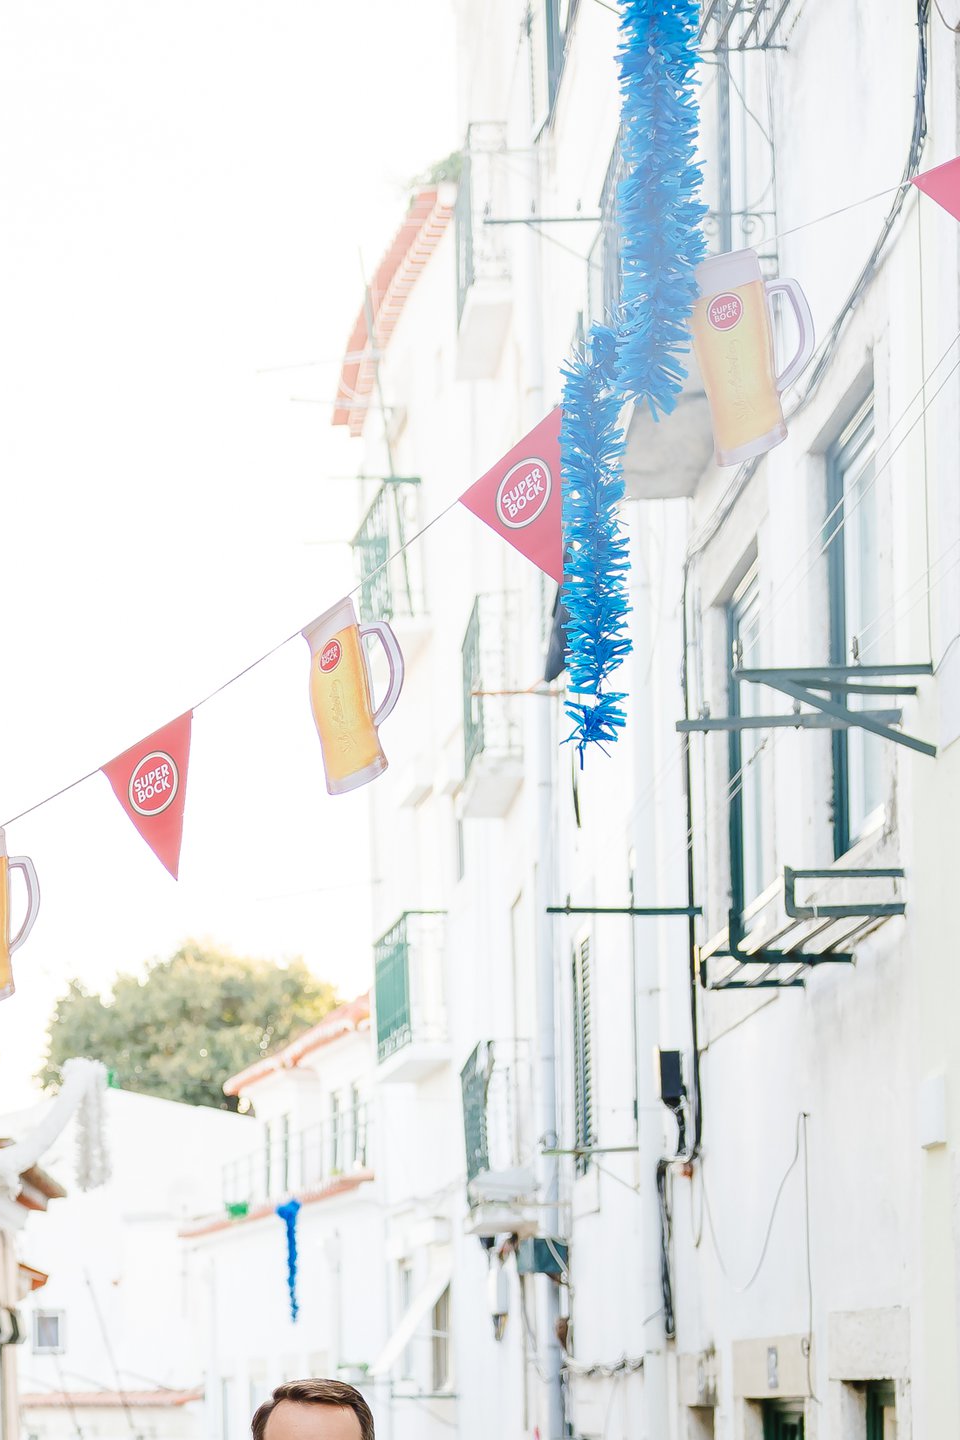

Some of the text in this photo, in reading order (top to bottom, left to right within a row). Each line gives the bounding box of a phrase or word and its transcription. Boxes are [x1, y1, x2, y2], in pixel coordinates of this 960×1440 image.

[711, 301, 738, 316] SUPER
[714, 309, 738, 323] BOCK
[502, 468, 542, 508] SUPER
[507, 480, 544, 518] BOCK
[134, 763, 170, 792] SUPER
[137, 776, 171, 803] BOCK
